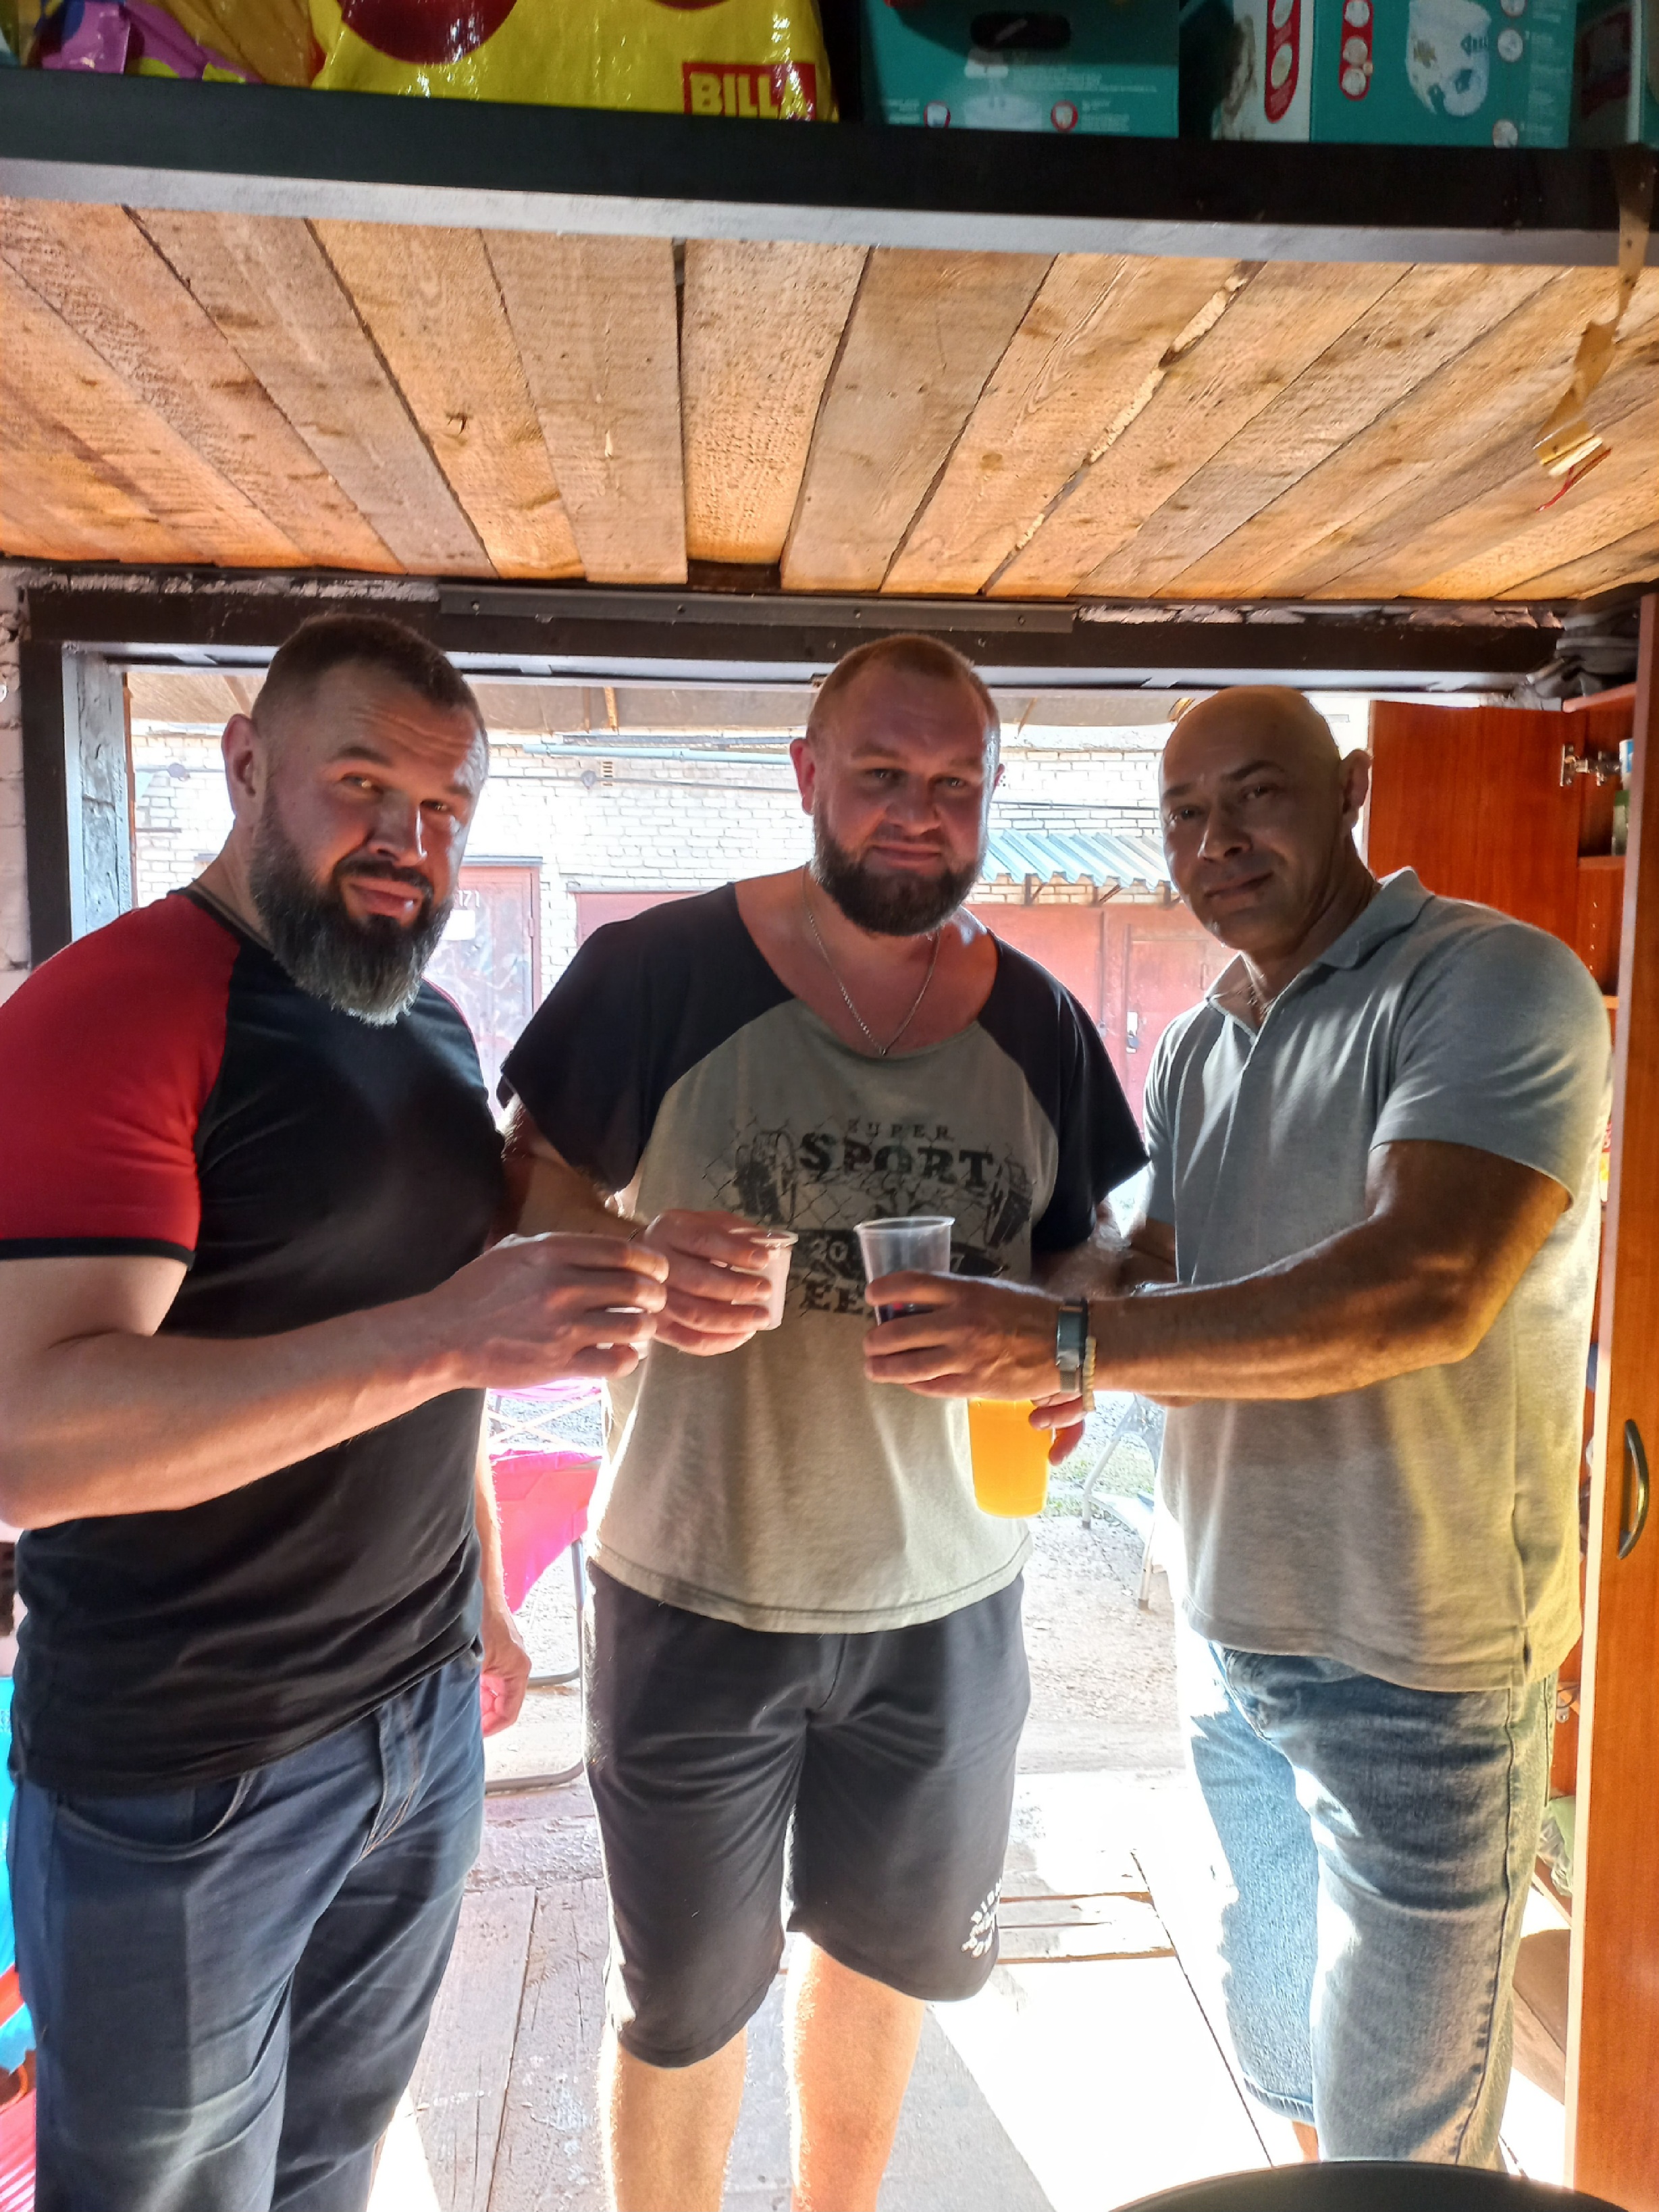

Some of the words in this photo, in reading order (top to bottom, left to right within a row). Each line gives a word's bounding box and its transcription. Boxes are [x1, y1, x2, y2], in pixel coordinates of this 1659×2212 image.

[690, 72, 810, 120] BILLA
[847, 1120, 954, 1142] SUPER
[799, 1132, 993, 1188] SPORT
